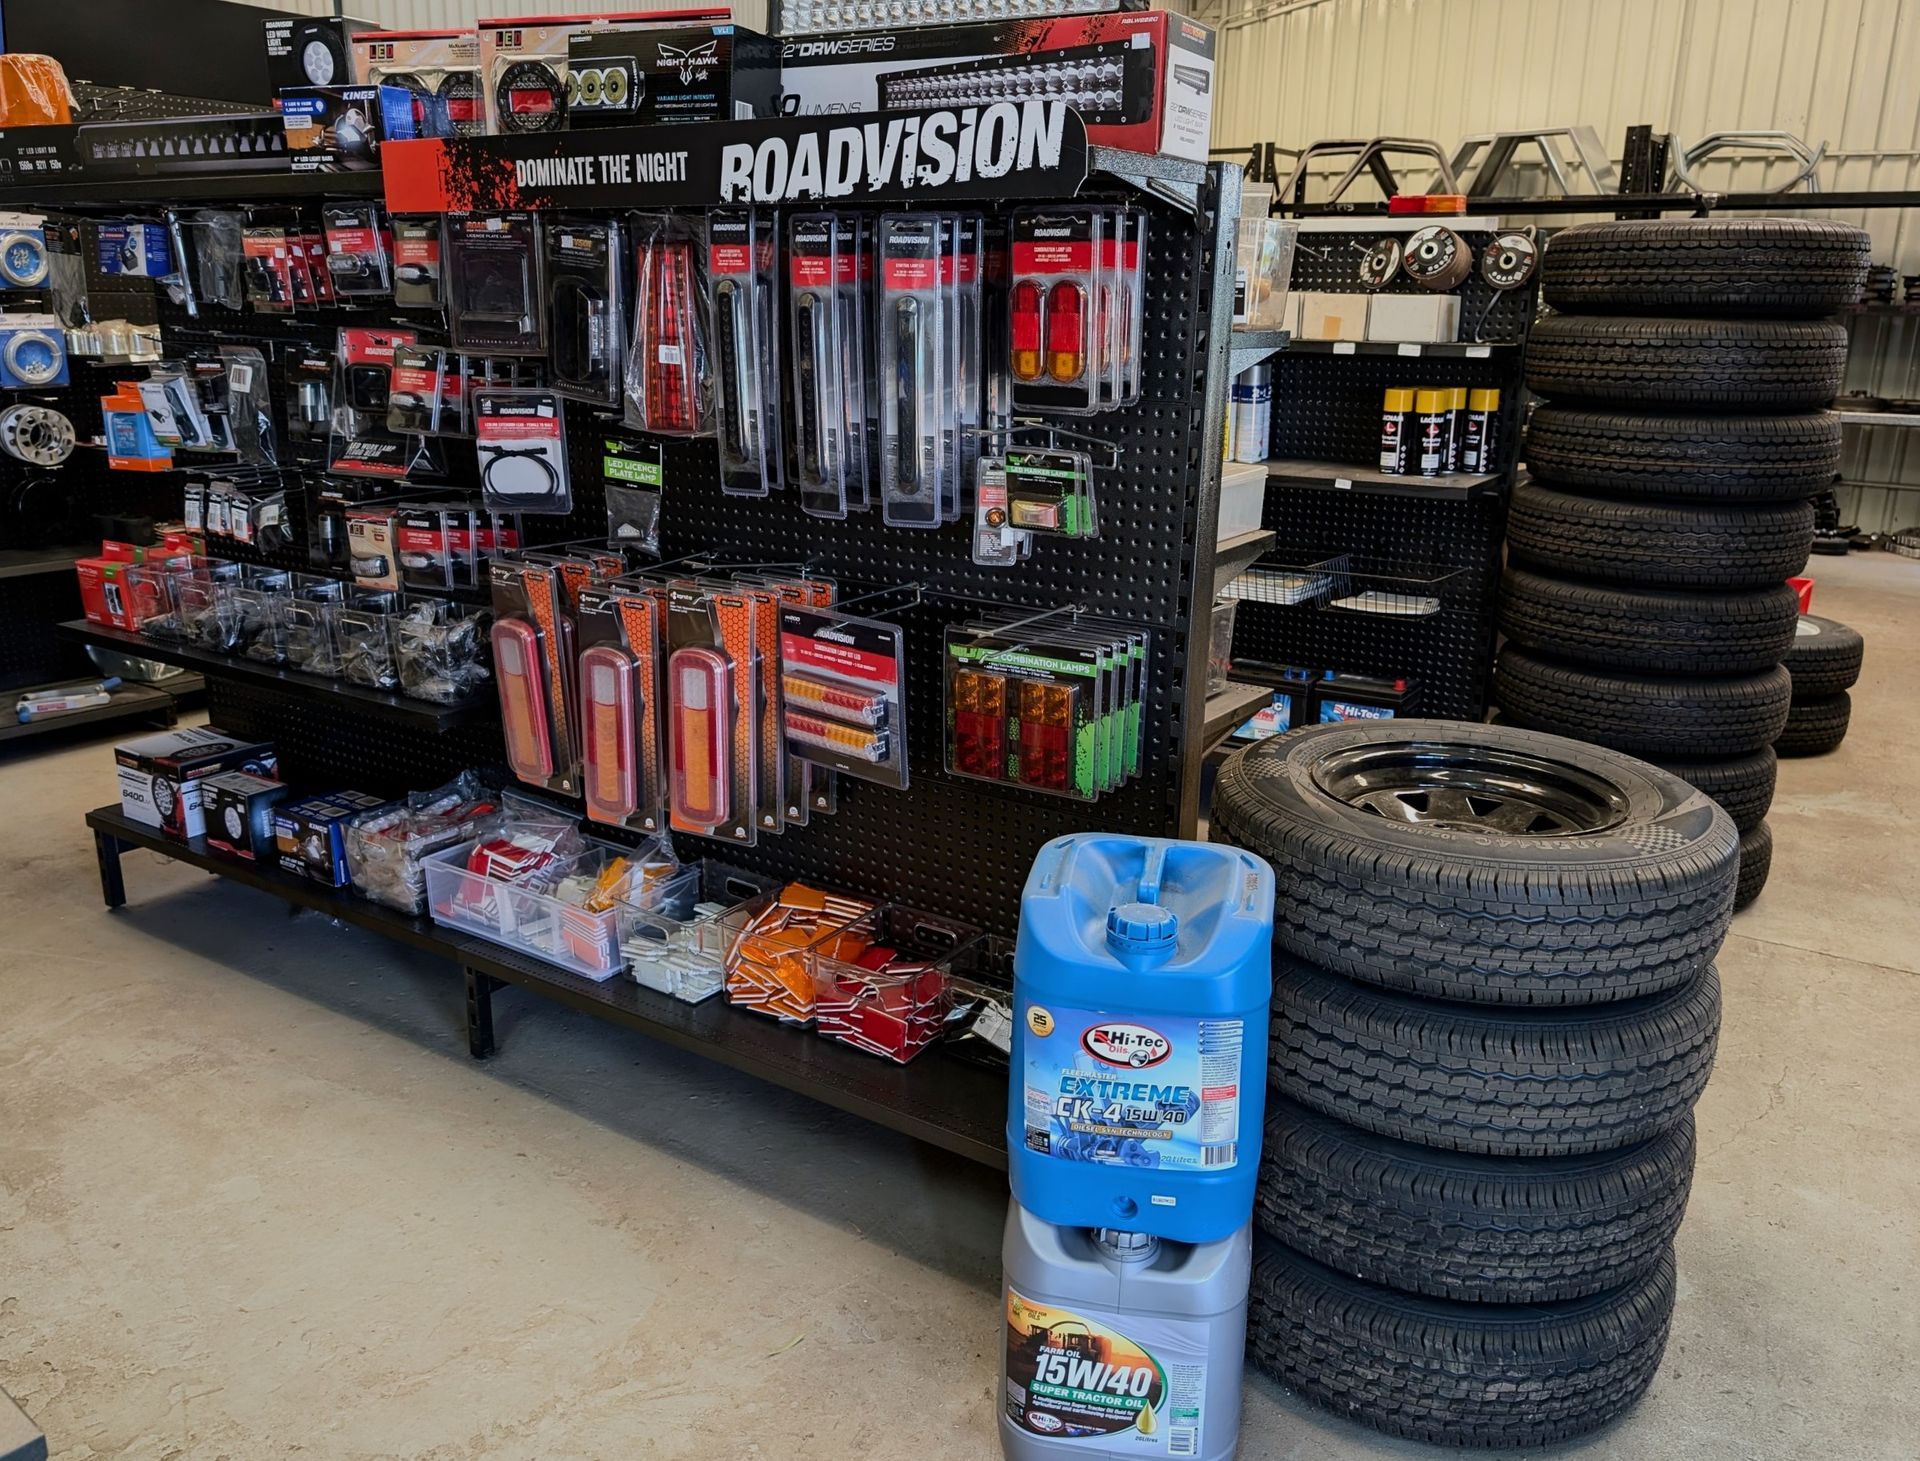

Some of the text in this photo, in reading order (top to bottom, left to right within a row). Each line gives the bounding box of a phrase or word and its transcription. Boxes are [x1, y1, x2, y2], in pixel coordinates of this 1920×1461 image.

[496, 31, 522, 46] LED
[369, 44, 394, 58] LED
[656, 56, 718, 67] NIGHT HAWK
[342, 90, 377, 100] KINGS
[720, 100, 1066, 203] ROADVISION
[516, 151, 688, 188] DOMINATE THE NIGHT
[795, 234, 828, 242] ROADVISION
[889, 236, 930, 244] ROADVISION
[1034, 229, 1071, 237] ROADVISION
[608, 459, 658, 475] LED LICENCE
[609, 468, 657, 482] PLATE LAMP
[815, 630, 856, 645] ROADVISION
[1000, 653, 1059, 669] COMBINATION
[1060, 662, 1090, 674] LAMPS
[1344, 706, 1380, 720] Hi-Tec
[122, 789, 145, 802] 6400
[1033, 1012, 1047, 1026] 25
[1110, 1031, 1164, 1048] Hi-Tec
[1061, 1068, 1118, 1081] FLEETMASTER
[1059, 1076, 1190, 1104] EXTREME
[1056, 1096, 1122, 1123] CK-4
[1073, 1124, 1169, 1138] DIESEL SYN TECHNOLOGY
[1028, 1311, 1041, 1321] OILS
[1039, 1345, 1080, 1358] FARM OIL
[1035, 1353, 1153, 1397] 15W/40
[1032, 1383, 1143, 1408] SUPER TRACTOR OIL
[1071, 1401, 1087, 1409] Super
[1087, 1404, 1106, 1412] Tractor
[1038, 1415, 1060, 1425] Hi-Tec
[1072, 1407, 1105, 1418] earthmoving
[1105, 1411, 1133, 1421] equipment
